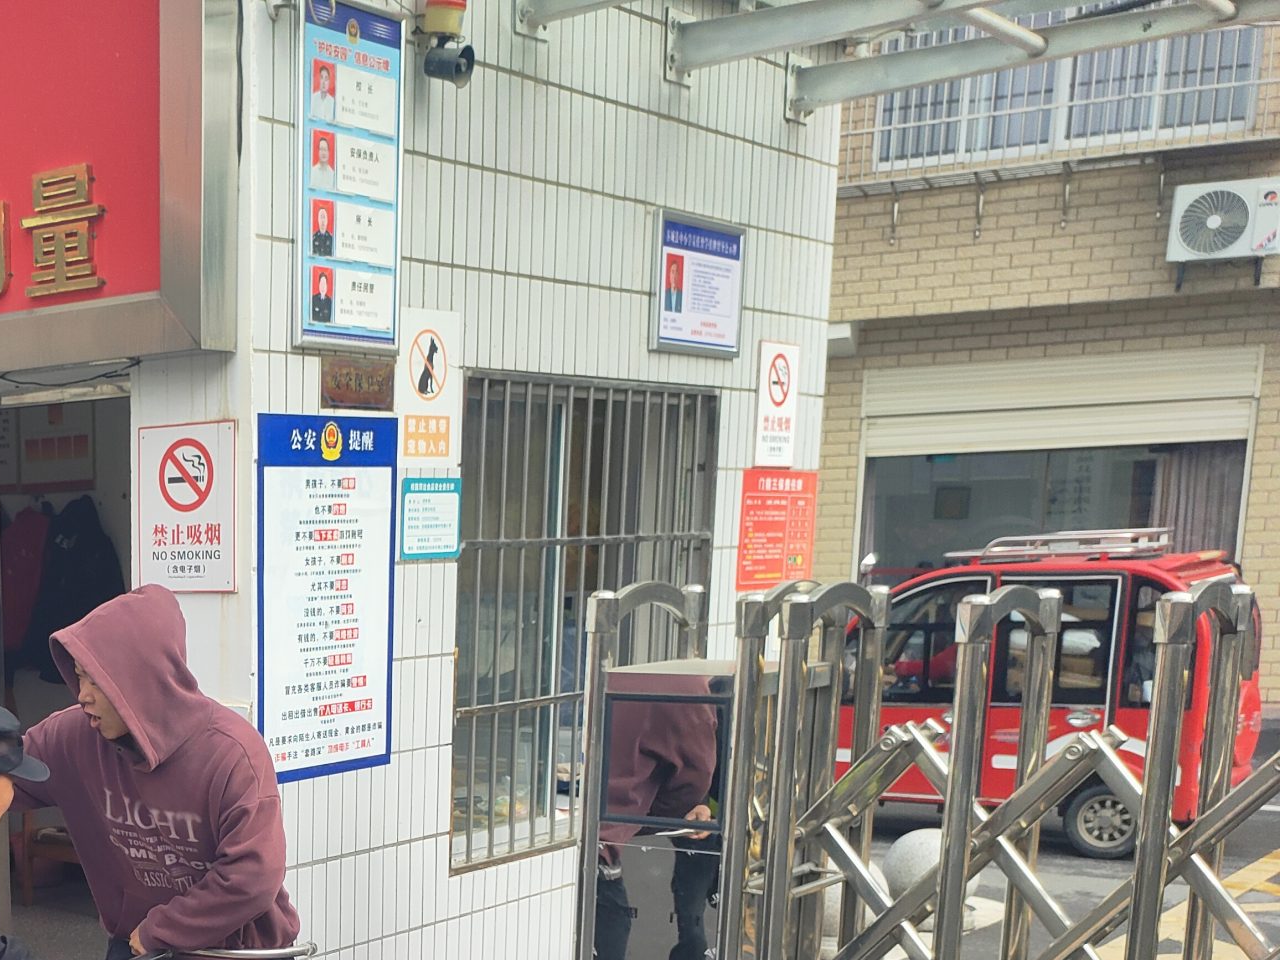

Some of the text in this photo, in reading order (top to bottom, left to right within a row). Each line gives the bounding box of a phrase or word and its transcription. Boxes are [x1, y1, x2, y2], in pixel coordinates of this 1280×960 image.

[290, 428, 374, 452] 公安 提醒
[152, 523, 221, 547] 禁止吸烟
[152, 550, 221, 561] NO SMOKING
[104, 787, 202, 843] LIGHT
